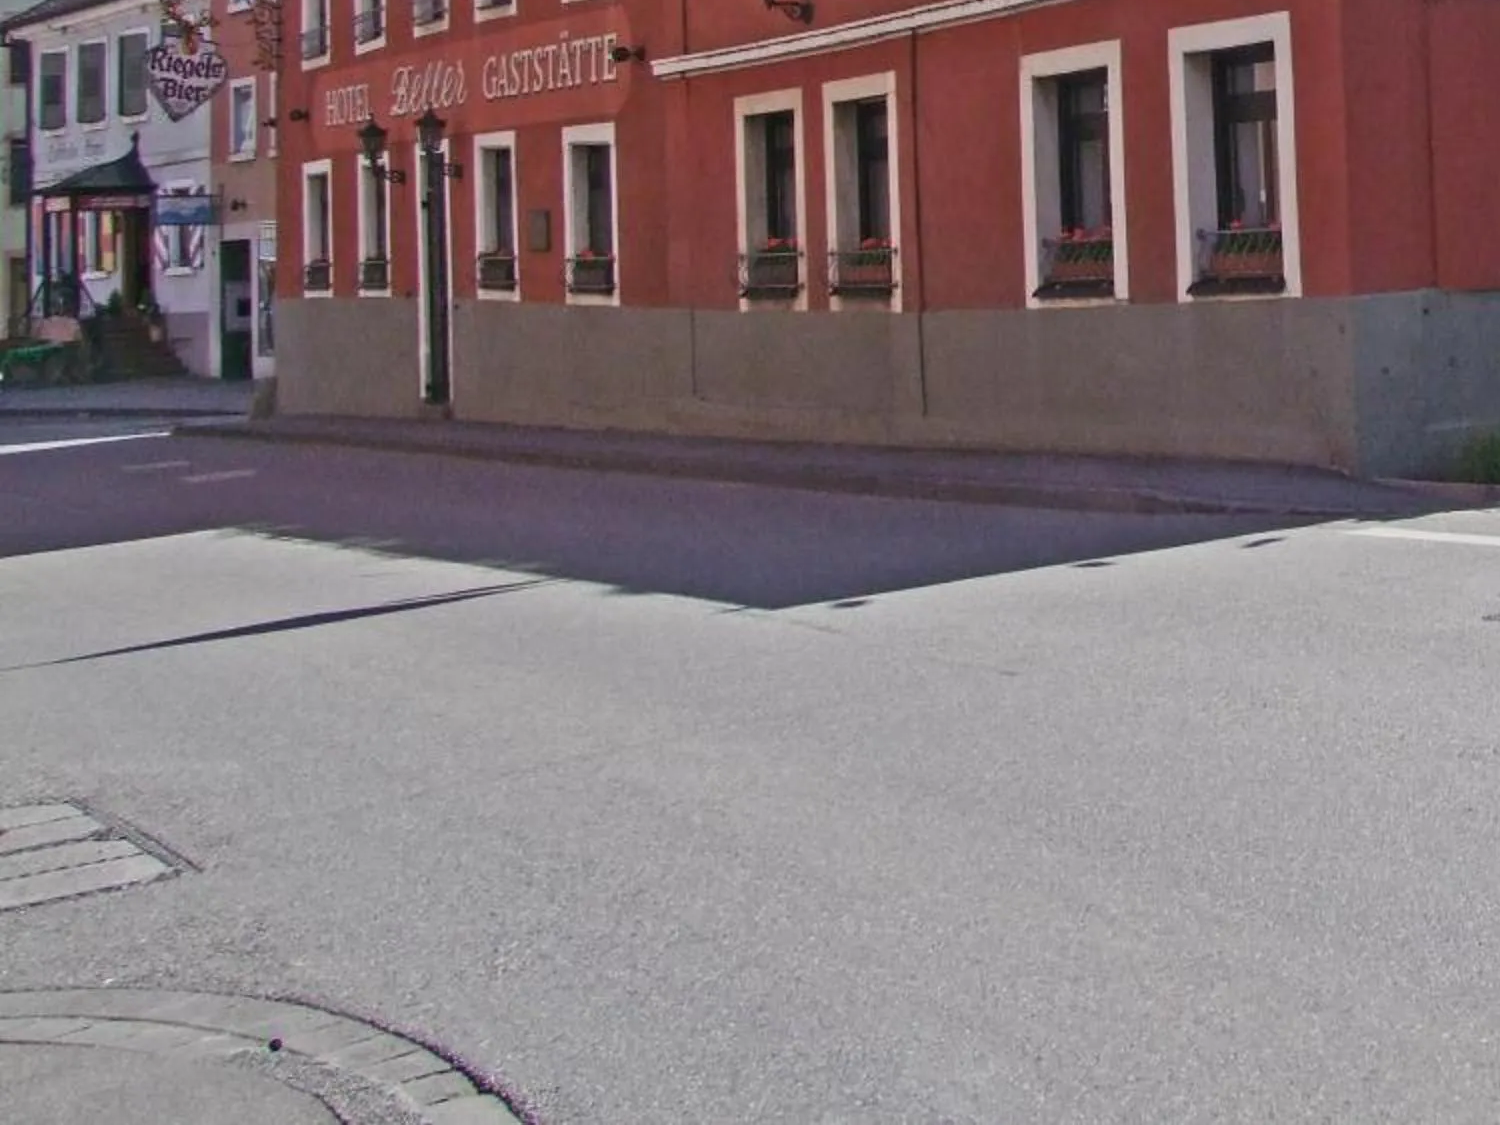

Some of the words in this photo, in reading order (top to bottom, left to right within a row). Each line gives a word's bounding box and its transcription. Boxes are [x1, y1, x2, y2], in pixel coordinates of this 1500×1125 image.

[152, 78, 208, 103] Bier
[325, 82, 373, 126] HOTEL
[388, 58, 468, 117] Beller
[481, 30, 618, 101] GASTSTÄTTE
